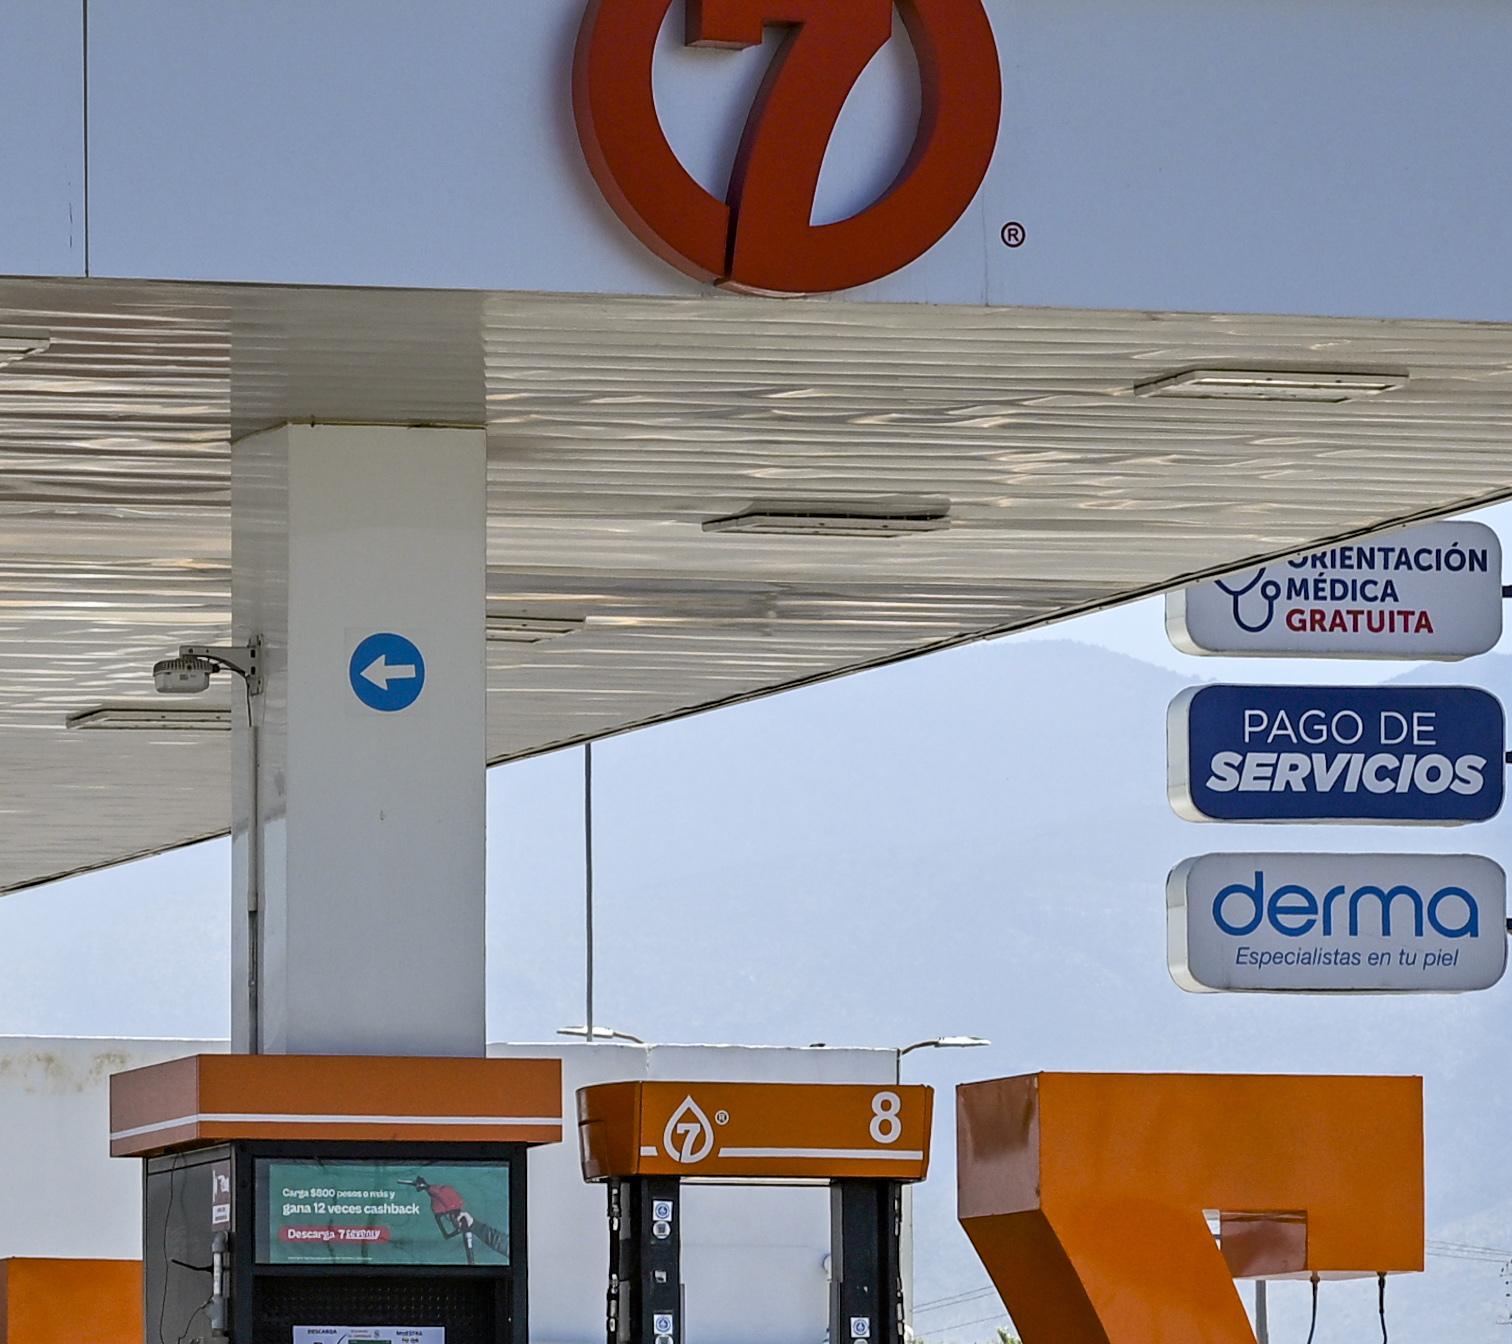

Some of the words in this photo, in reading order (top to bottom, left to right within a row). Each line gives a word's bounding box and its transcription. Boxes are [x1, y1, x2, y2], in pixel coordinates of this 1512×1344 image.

[1287, 541, 1488, 572] ORIENTACIÓN
[1286, 572, 1399, 602] MÉDICA
[1285, 608, 1434, 634] GRATUITA
[1243, 709, 1364, 745] PAGO
[1380, 711, 1437, 746] DE
[1205, 751, 1488, 796] SERVICIOS
[1212, 870, 1479, 938] derma
[1235, 946, 1362, 971] Especialistas
[1367, 952, 1391, 967] en
[1398, 948, 1417, 966] tu
[1422, 948, 1459, 971] piel
[869, 1090, 902, 1144] 8
[282, 1188, 309, 1200] Carga
[282, 1203, 311, 1216] gana
[313, 1202, 326, 1213] 12
[327, 1204, 362, 1214] veces
[364, 1203, 420, 1215] cashback
[287, 1228, 335, 1241] Descarga
